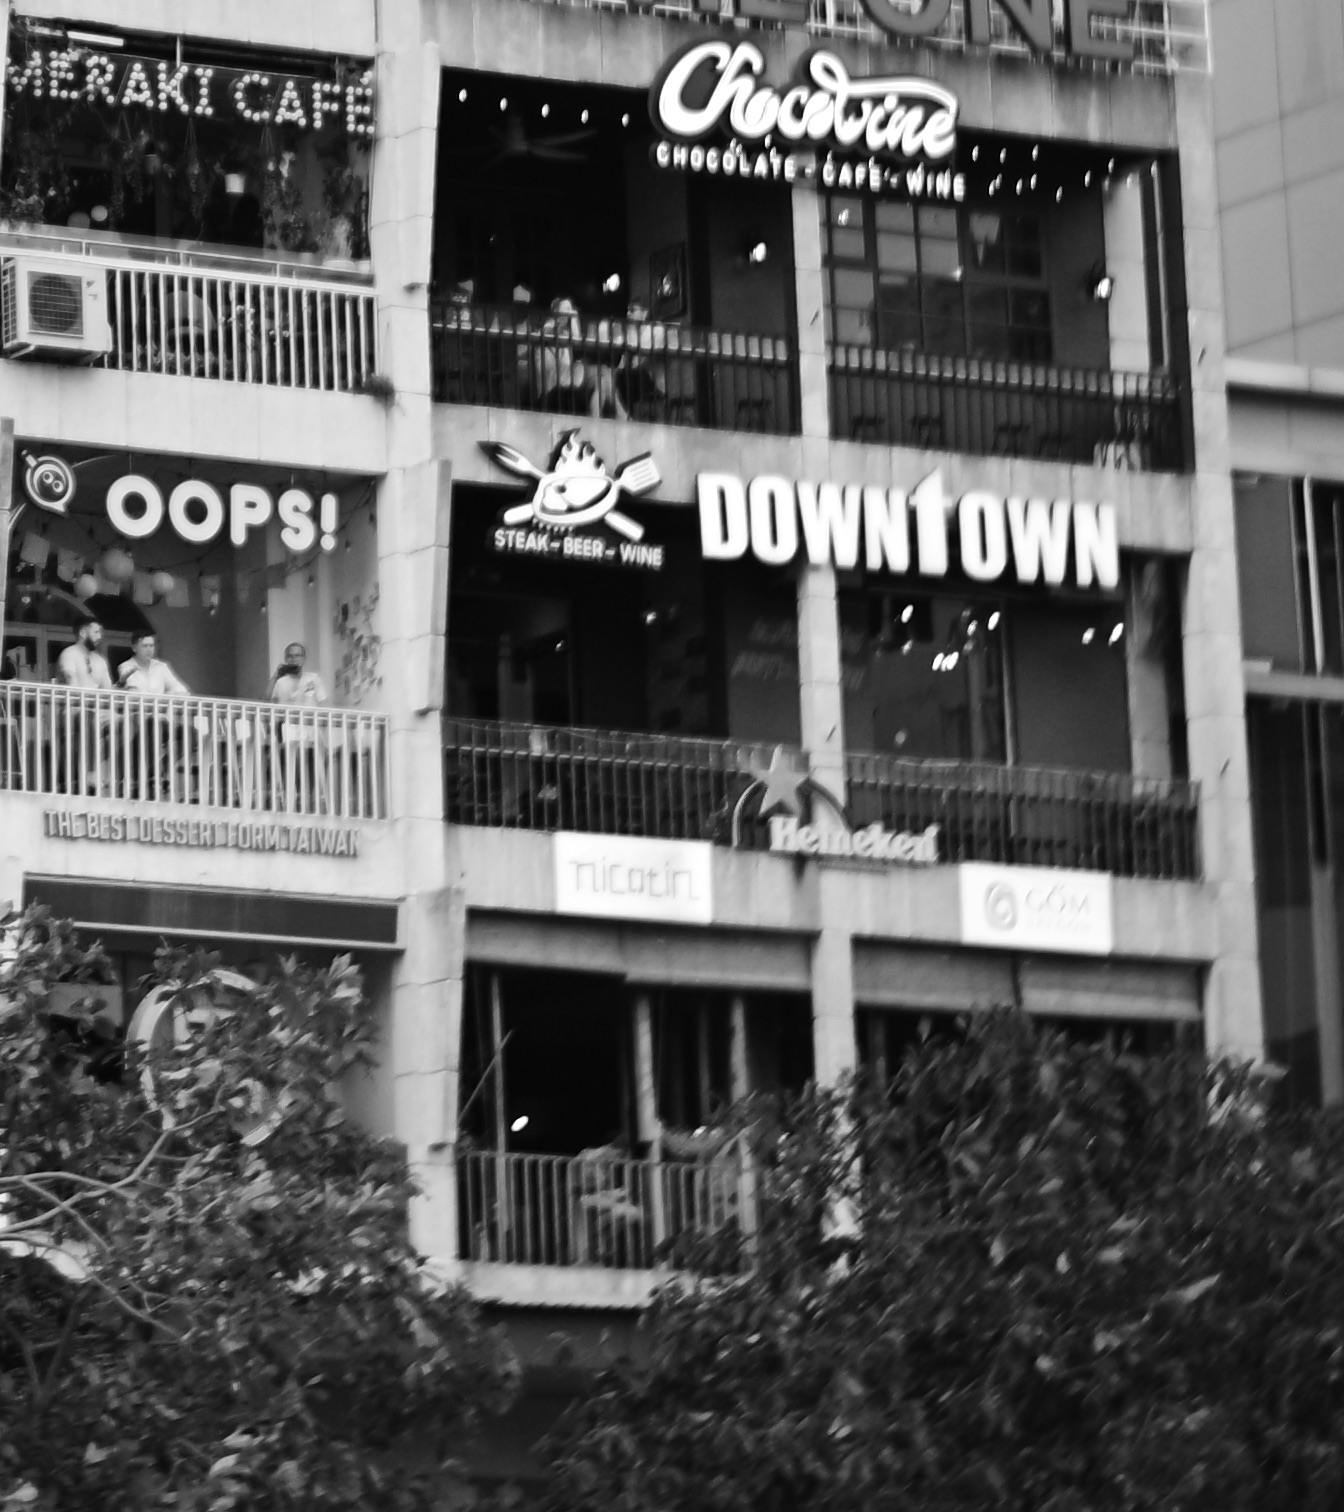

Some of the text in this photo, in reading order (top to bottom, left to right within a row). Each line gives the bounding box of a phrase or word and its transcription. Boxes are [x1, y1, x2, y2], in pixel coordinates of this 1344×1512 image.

[6, 51, 214, 116] MERAKI
[656, 140, 797, 183] CHOCOLATE
[906, 167, 967, 202] WINE
[106, 473, 340, 553] OOPS!
[494, 529, 664, 568] STEAK BEER WINE
[44, 810, 86, 839] THE
[86, 813, 131, 842] BEST
[769, 815, 940, 864] Heineken
